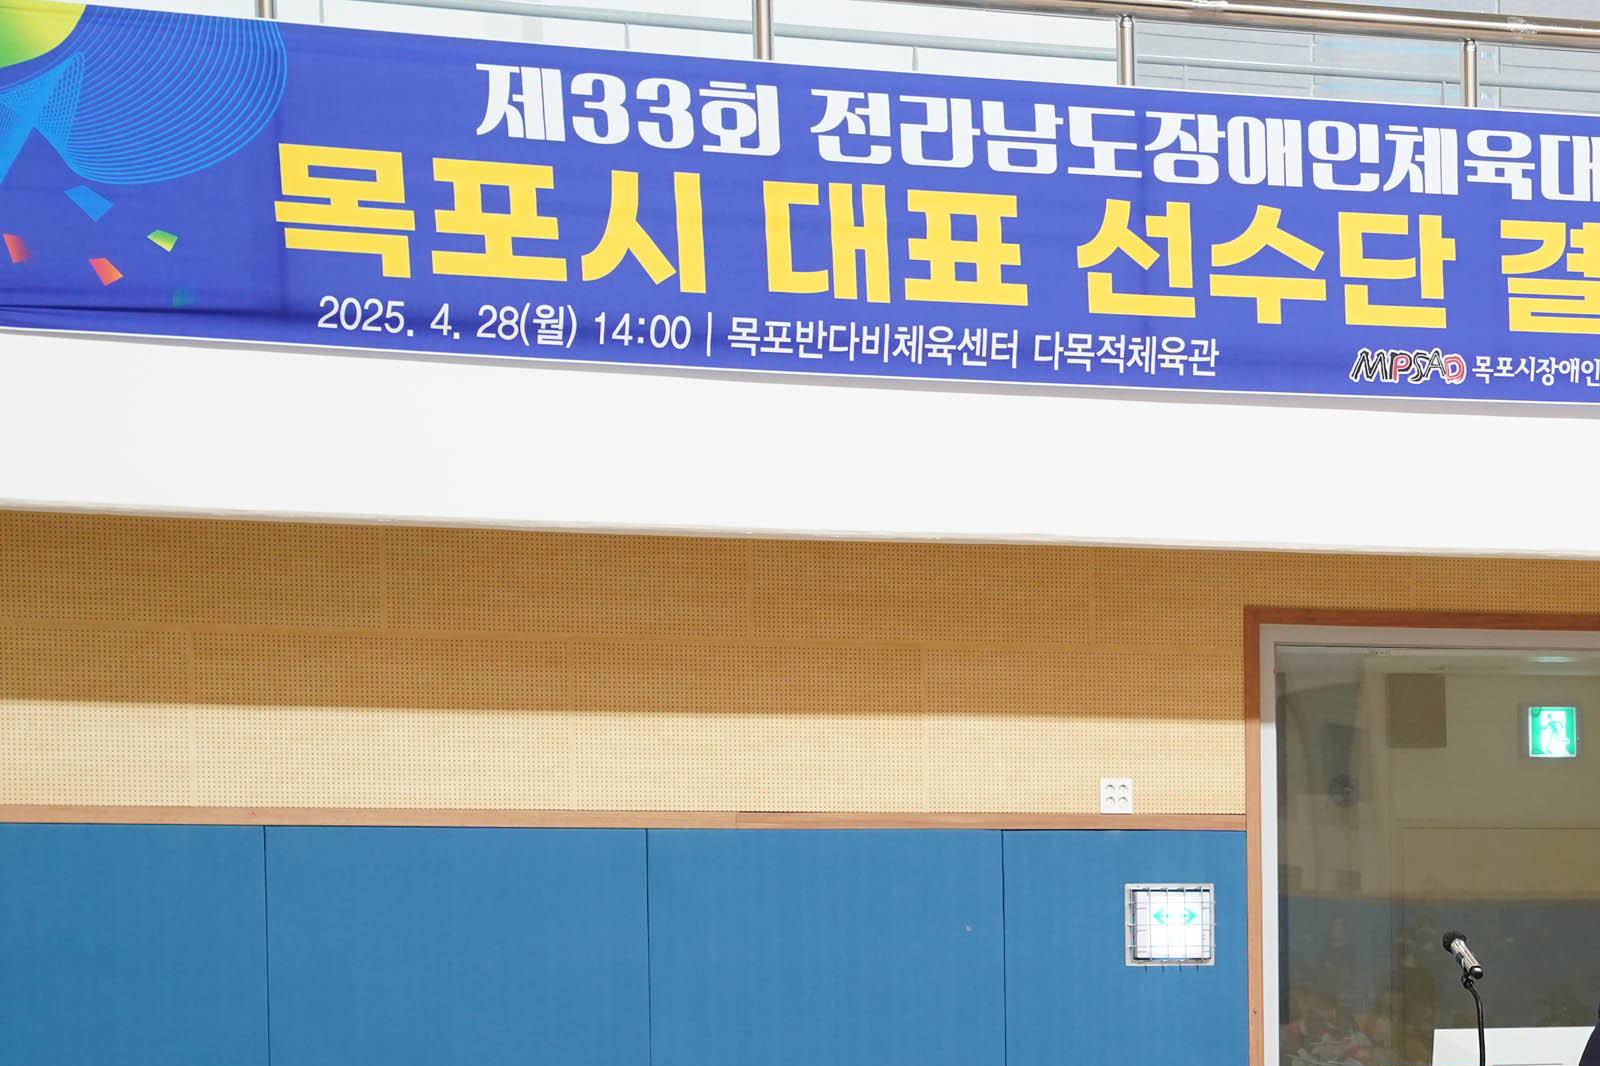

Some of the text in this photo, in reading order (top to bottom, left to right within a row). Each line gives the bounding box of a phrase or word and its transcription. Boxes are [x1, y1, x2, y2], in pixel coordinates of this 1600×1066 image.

[475, 62, 782, 157] 제33회
[274, 142, 707, 293] 목포시
[763, 180, 1028, 306] 대표
[1077, 198, 1456, 330] 선수단
[317, 295, 1220, 376] 2025. 4. 28(월) 14:00 목포반다비체육센터 다목적체육관
